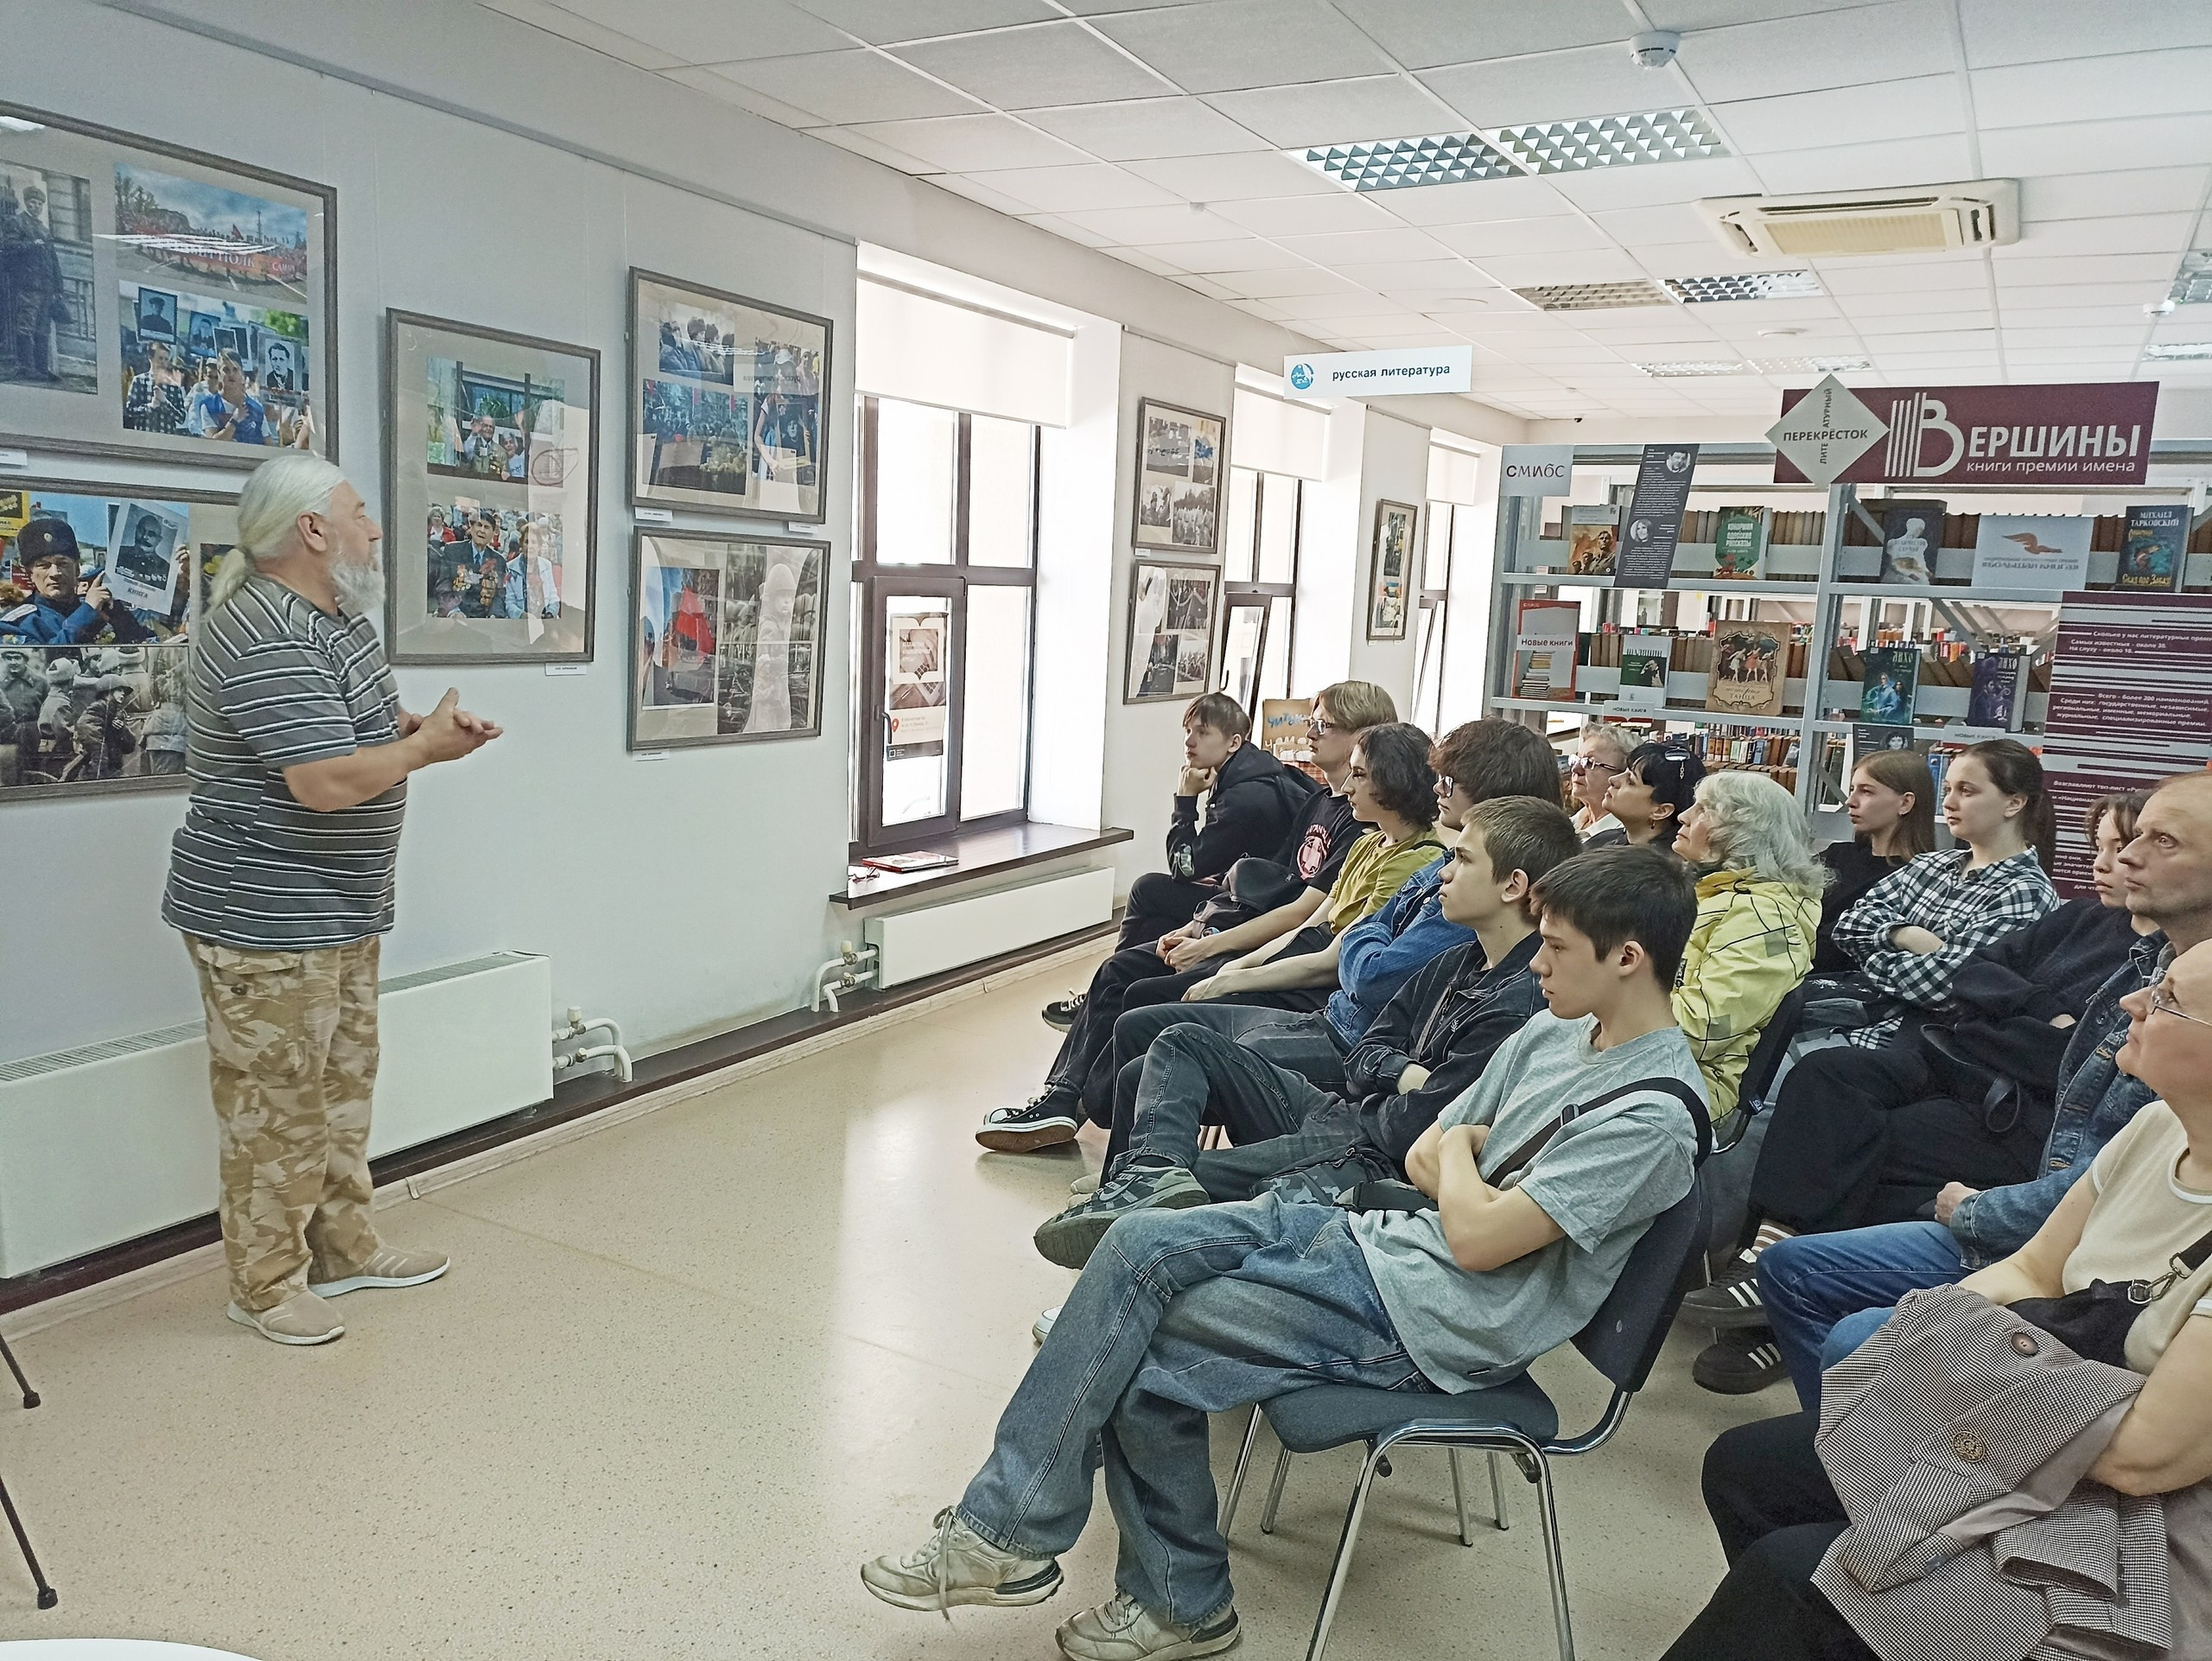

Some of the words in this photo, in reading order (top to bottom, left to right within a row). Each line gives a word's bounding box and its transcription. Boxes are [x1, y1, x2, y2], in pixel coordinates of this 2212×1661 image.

[1332, 368, 1376, 381] русская
[1381, 365, 1450, 377] литература
[1783, 430, 1868, 442] ПЕРЕКРЕСТОК
[1966, 461, 2012, 474] книги
[2016, 462, 2078, 474] премии
[2082, 461, 2135, 473] имена
